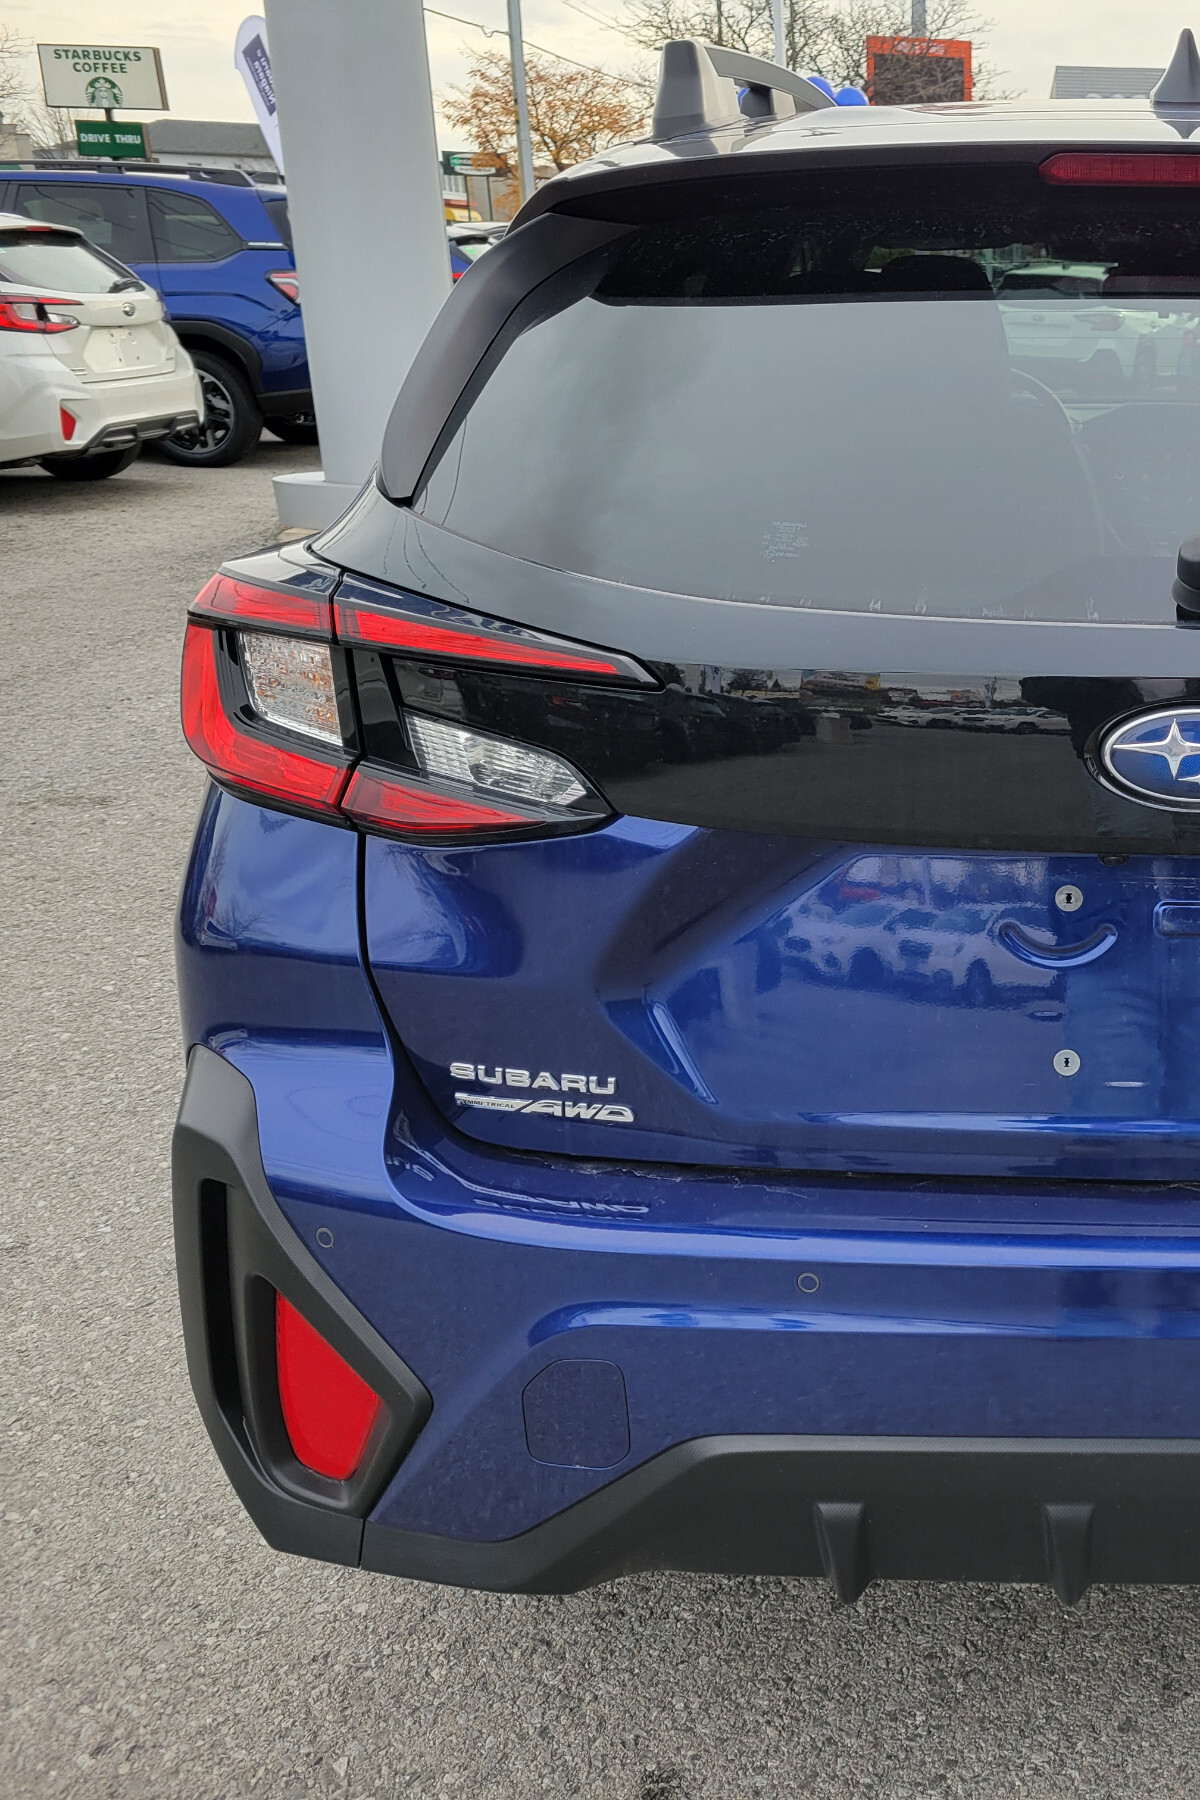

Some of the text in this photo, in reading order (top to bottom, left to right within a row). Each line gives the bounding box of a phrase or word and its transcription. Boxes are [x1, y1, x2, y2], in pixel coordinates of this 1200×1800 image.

[53, 49, 142, 62] STARBUCKS
[72, 62, 128, 74] COFFEE
[80, 133, 142, 145] DRIVE THRU
[449, 1062, 617, 1095] SUBARU
[520, 1099, 635, 1123] AWD
